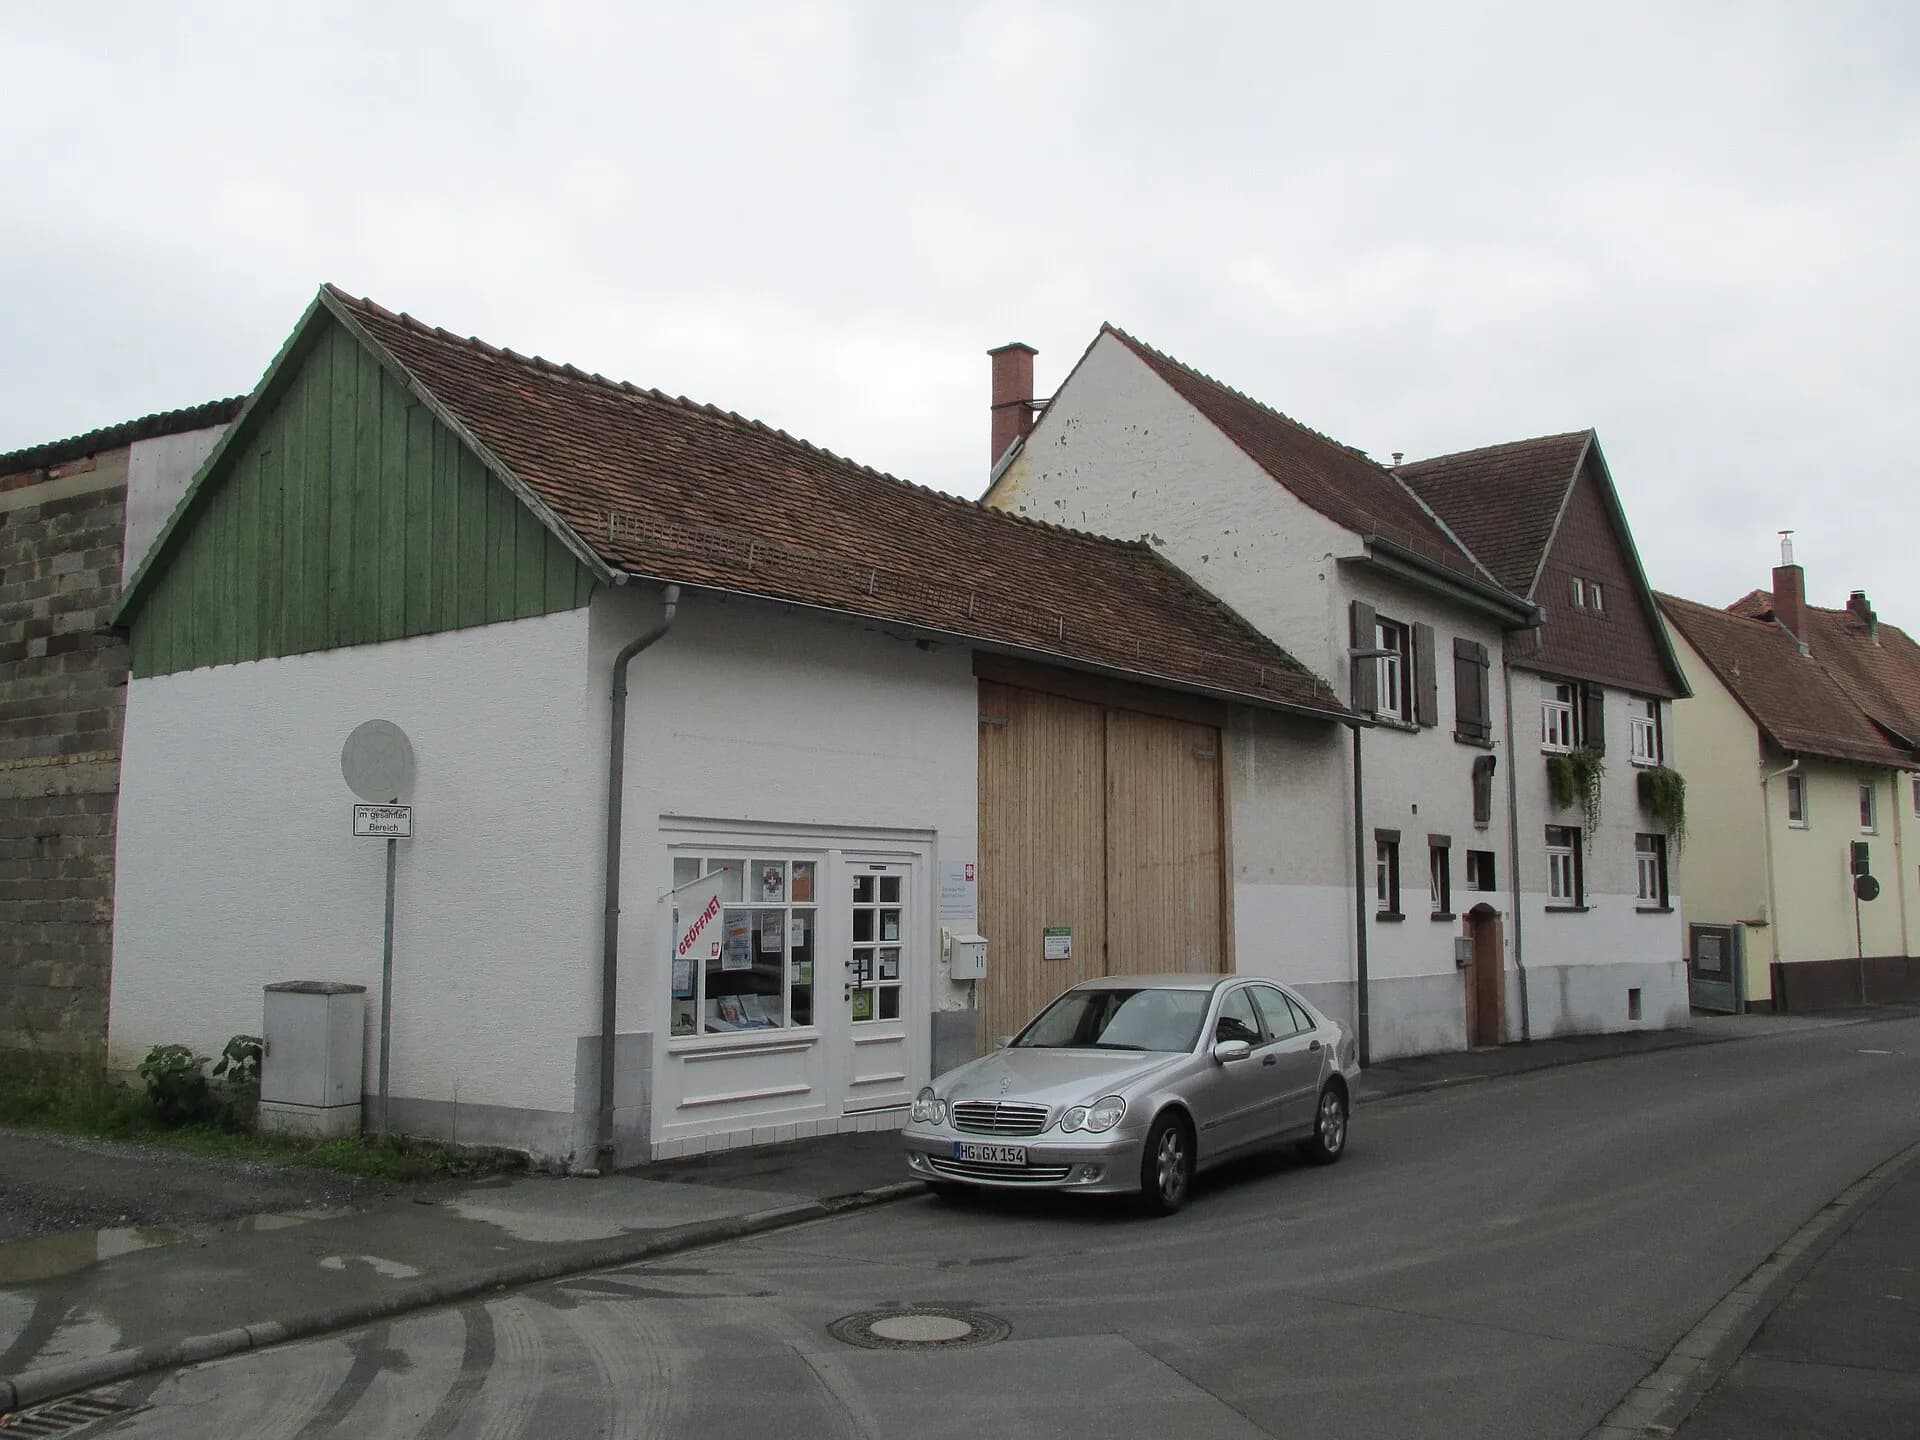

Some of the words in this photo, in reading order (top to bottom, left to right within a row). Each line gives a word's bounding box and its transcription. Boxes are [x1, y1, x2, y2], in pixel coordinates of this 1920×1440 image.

[370, 811, 407, 819] gesamten
[369, 823, 398, 831] Bereich
[679, 895, 721, 955] GEÖFFNET
[975, 955, 984, 968] 11
[960, 1145, 975, 1159] HG
[982, 1147, 998, 1161] GX
[1000, 1148, 1024, 1162] 154
